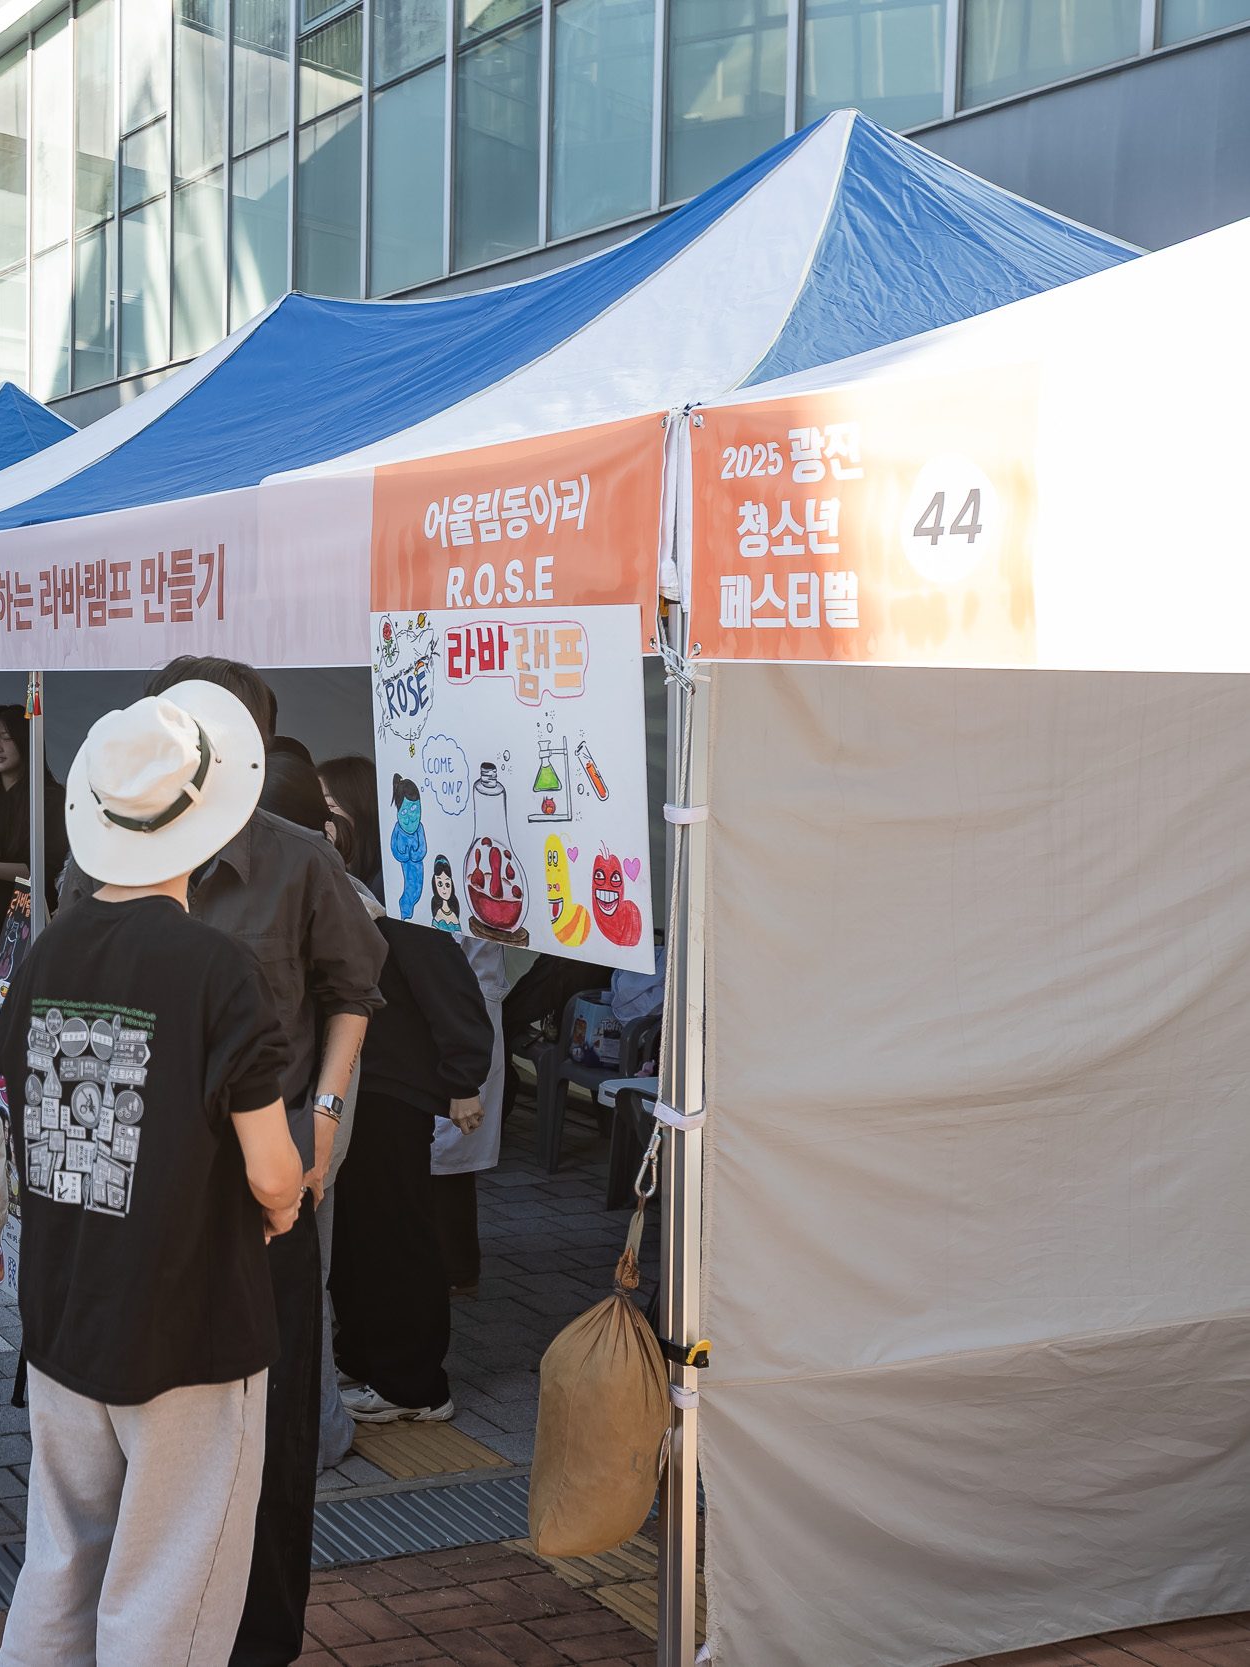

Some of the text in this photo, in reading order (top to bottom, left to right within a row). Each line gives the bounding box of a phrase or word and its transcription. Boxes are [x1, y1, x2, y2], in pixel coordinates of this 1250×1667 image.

[721, 422, 865, 484] 2025 광진
[423, 473, 591, 549] 어울림동아리
[736, 497, 840, 559] 청소년
[912, 488, 984, 546] 44
[38, 560, 134, 630] 라바램프
[140, 542, 226, 625] 만들기
[445, 555, 555, 609] R.O.S.E
[719, 570, 860, 630] 페스티벌
[446, 624, 585, 702] 라바램프
[385, 670, 429, 720] ROSE
[426, 755, 454, 776] COME
[441, 780, 464, 802] ON!
